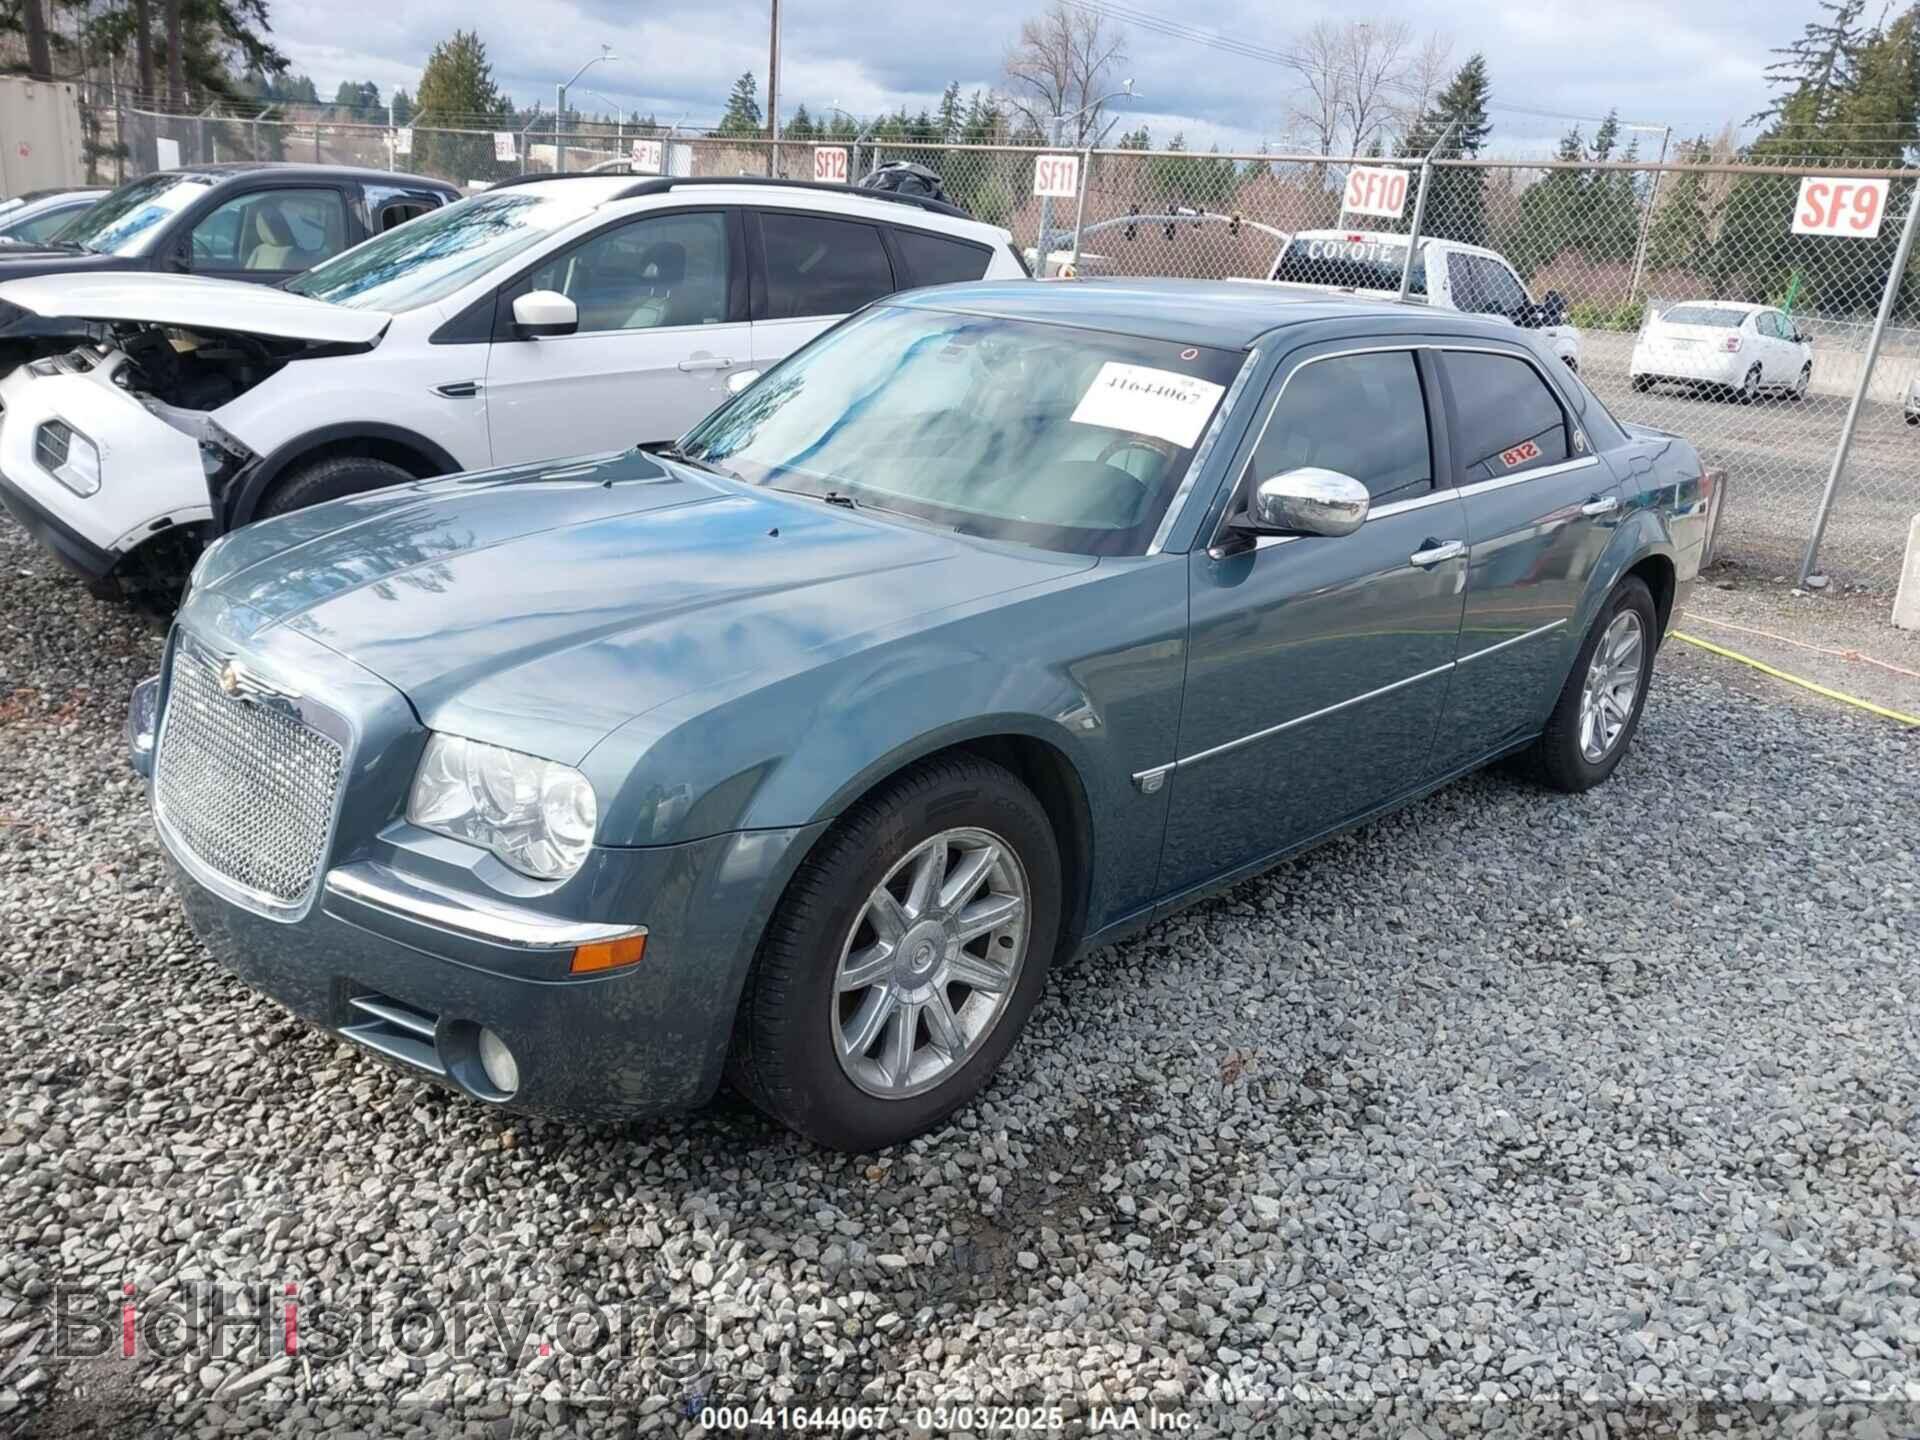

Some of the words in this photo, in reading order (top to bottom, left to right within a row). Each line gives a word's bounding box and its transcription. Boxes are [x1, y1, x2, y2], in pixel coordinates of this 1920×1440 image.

[816, 151, 845, 178] SF12
[1039, 160, 1073, 191] SF11
[1348, 170, 1405, 211] SF10
[1801, 182, 1879, 230] SF9
[1308, 241, 1395, 261] COYOTE
